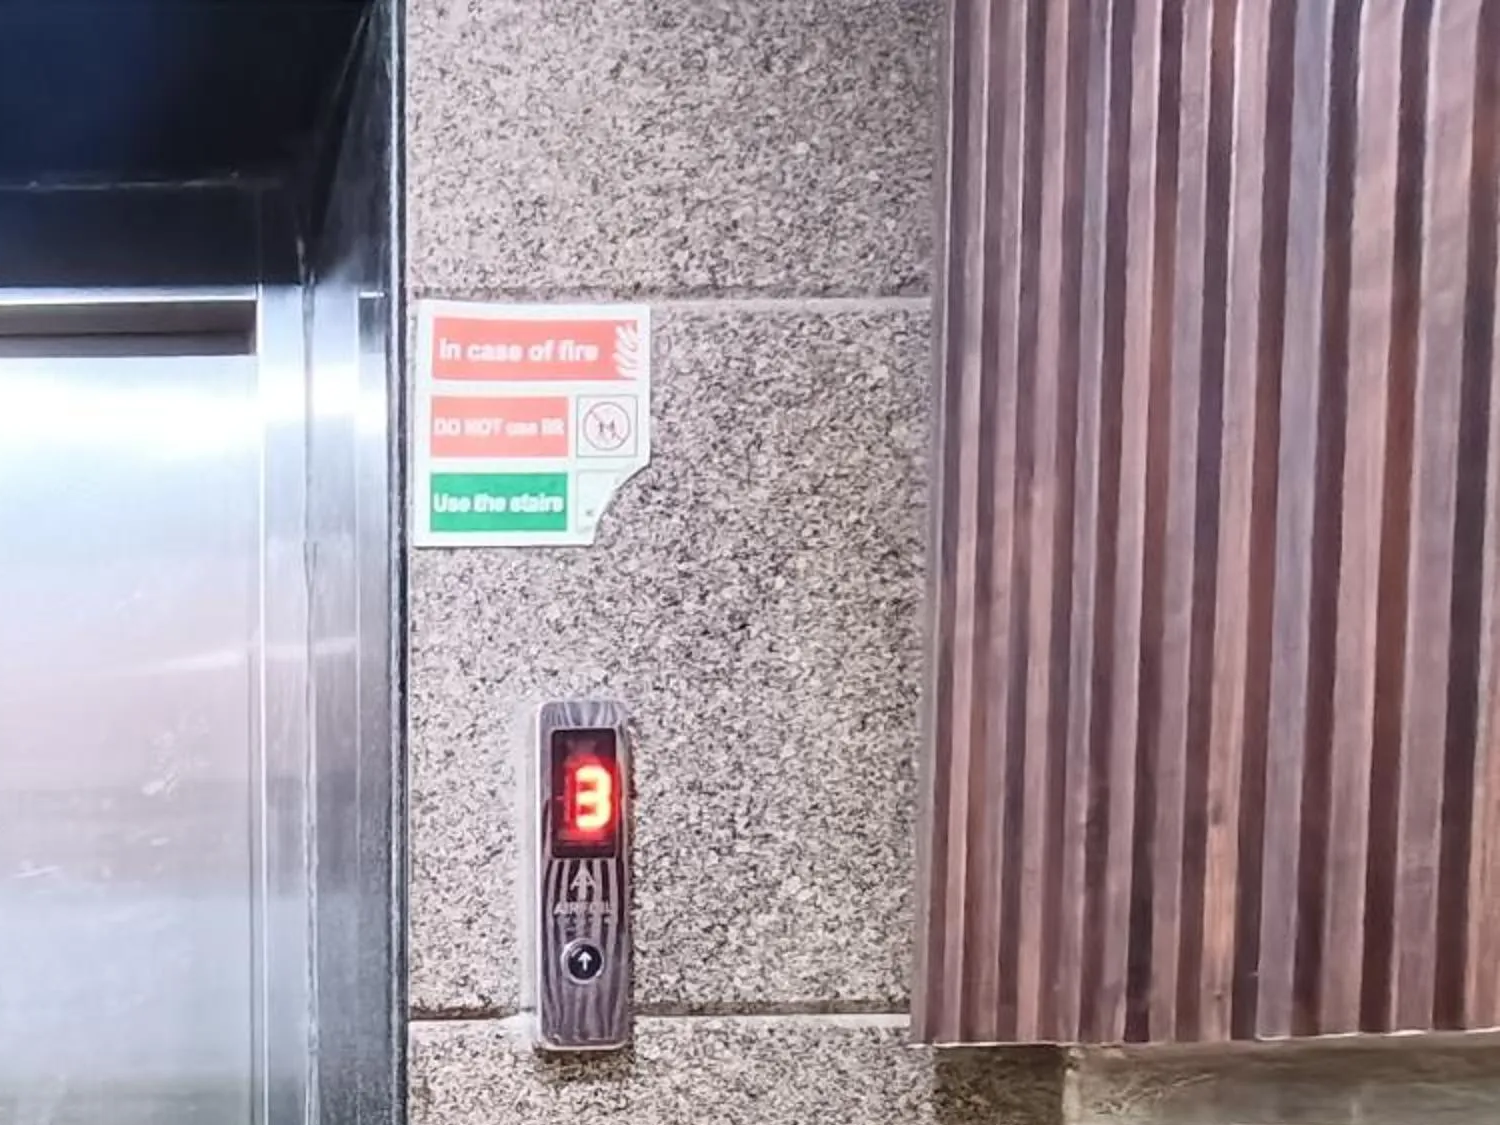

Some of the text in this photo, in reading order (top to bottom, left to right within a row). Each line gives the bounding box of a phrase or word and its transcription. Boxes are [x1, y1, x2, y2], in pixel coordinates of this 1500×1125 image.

[438, 337, 598, 362] In case of fire
[433, 491, 471, 513] Use
[474, 492, 507, 513] the
[575, 763, 612, 831] 3
